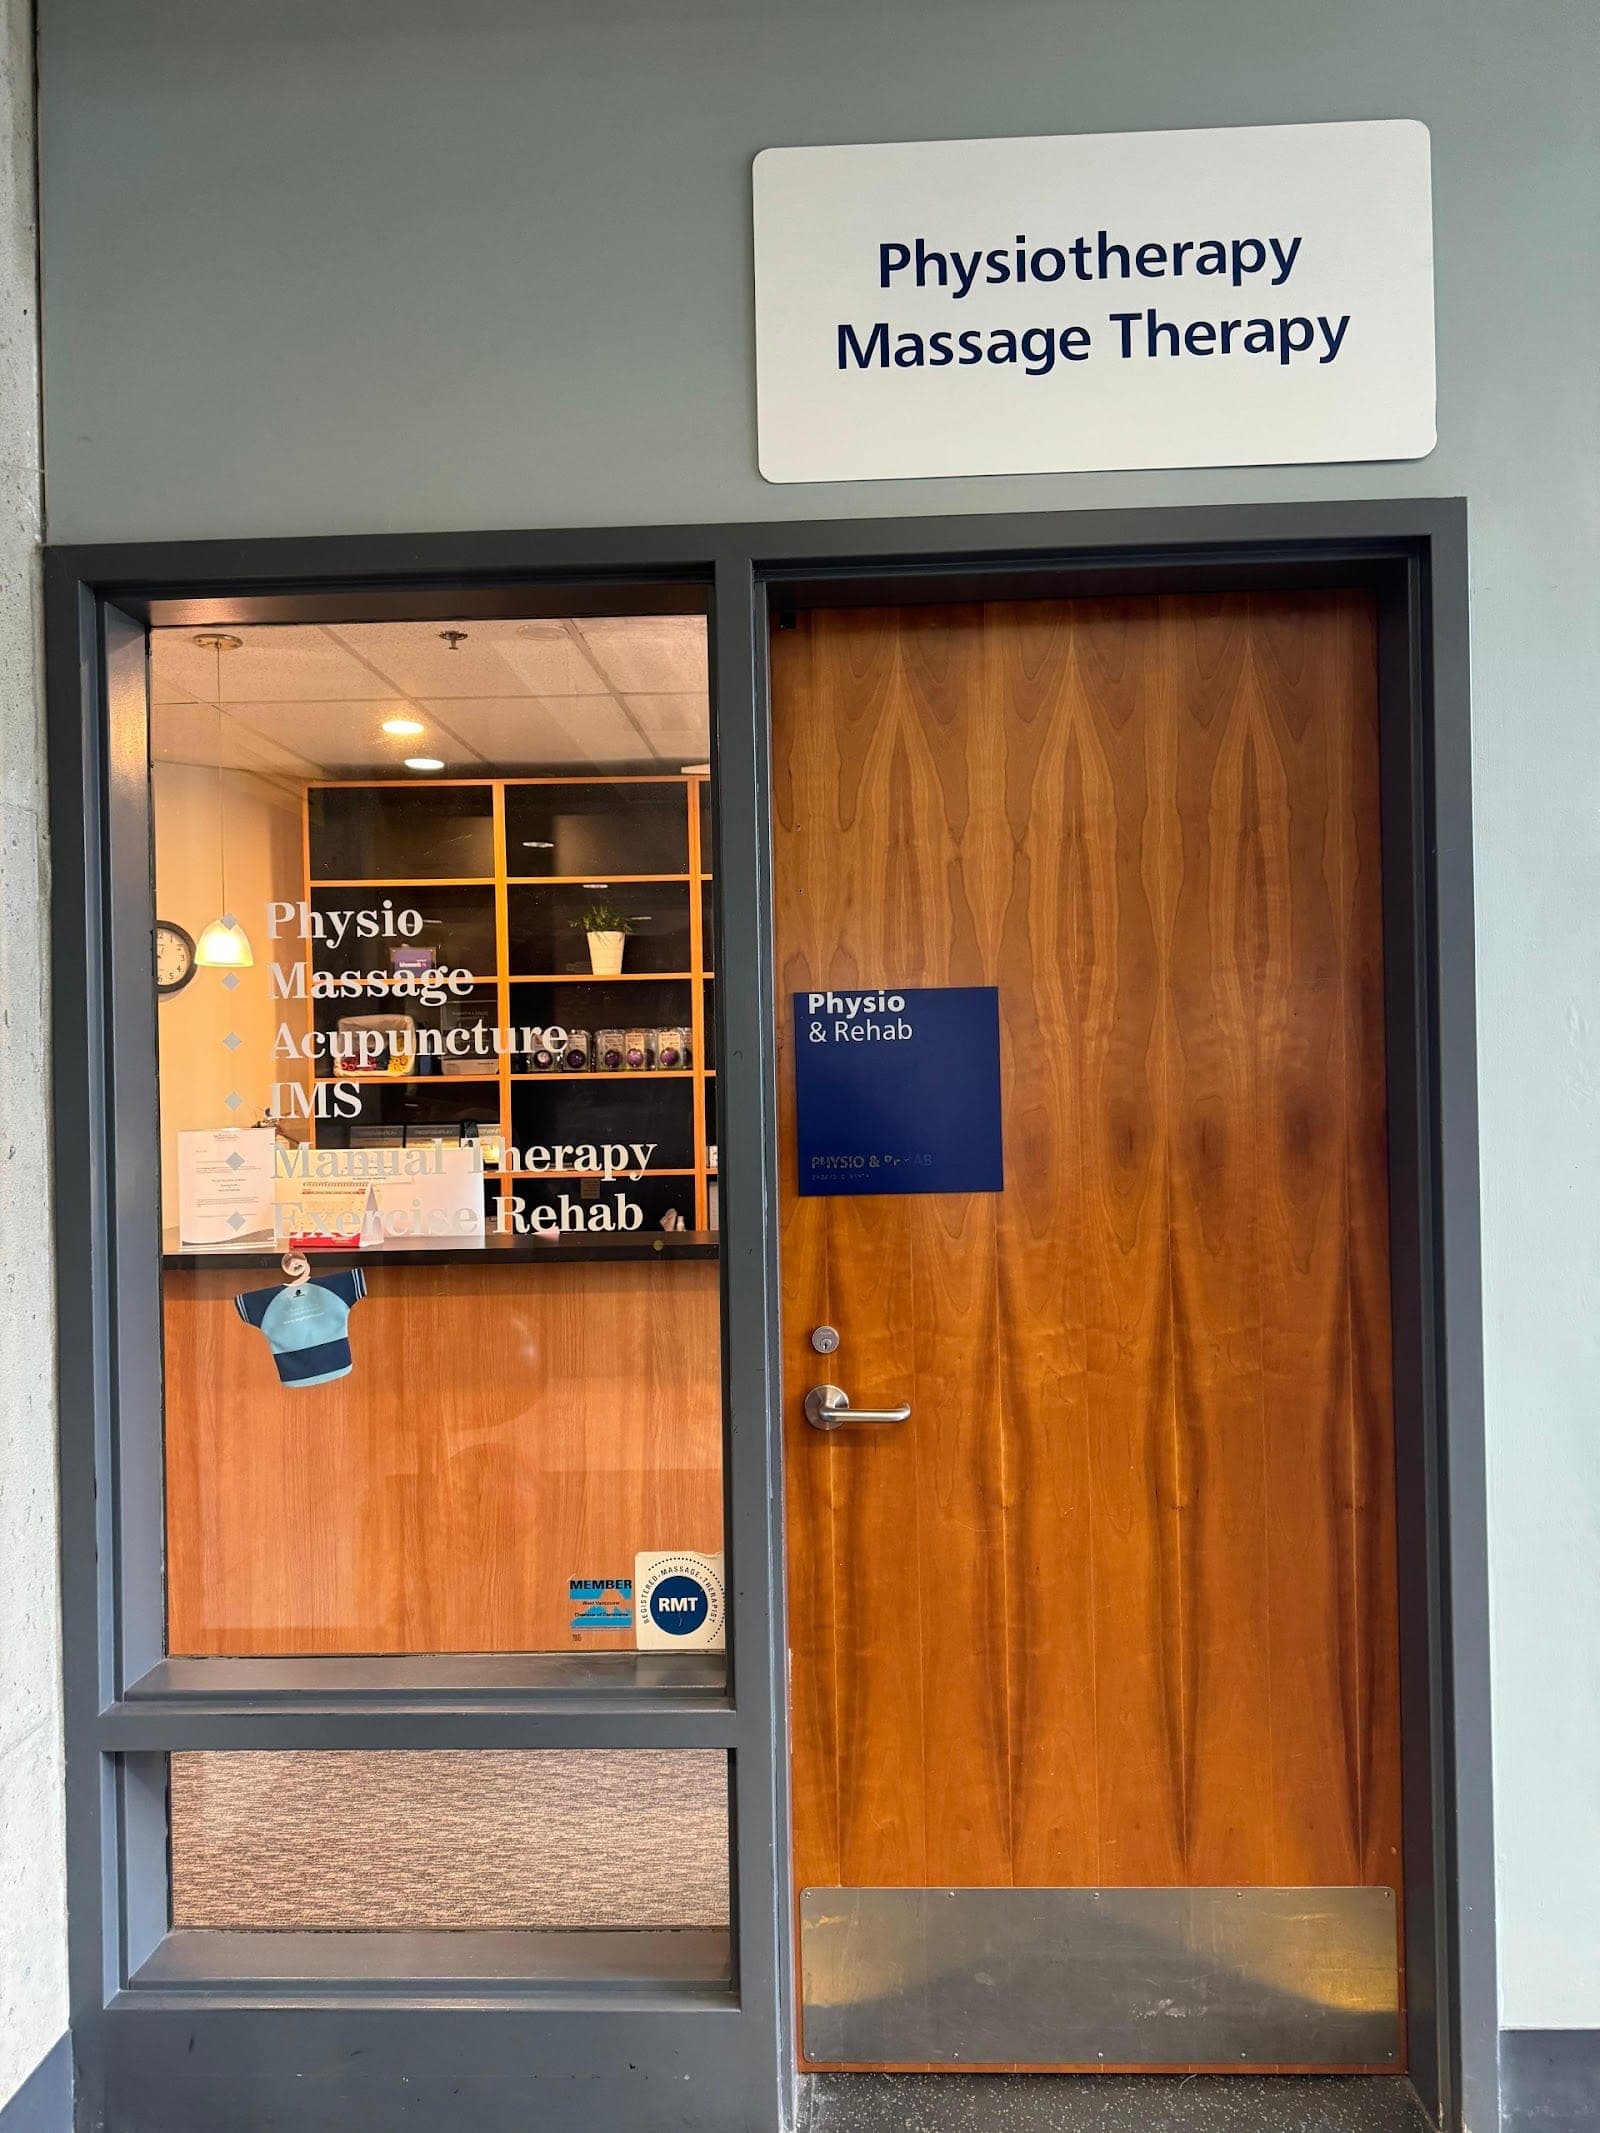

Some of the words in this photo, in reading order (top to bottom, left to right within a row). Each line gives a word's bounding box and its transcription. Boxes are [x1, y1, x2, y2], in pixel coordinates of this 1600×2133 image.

[879, 230, 1303, 299] Physiotherapy
[836, 322, 1091, 376] Massage
[1109, 308, 1351, 366] Therapy
[266, 899, 425, 949] Physio
[266, 961, 475, 1006] Massage
[808, 990, 906, 1019] Physio
[269, 1020, 569, 1069] Acupuncture
[808, 1021, 828, 1043] &
[834, 1018, 913, 1042] Rehab
[267, 1081, 363, 1119] IMS
[268, 1137, 446, 1180] Manual
[460, 1136, 658, 1182] Therapy
[811, 1155, 865, 1169] PHYSIO
[868, 1154, 880, 1168] &
[269, 1199, 479, 1239] Exercise
[491, 1193, 644, 1234] Rehab
[569, 1579, 632, 1590] MEMBER
[658, 1597, 699, 1613] RMT
[660, 1565, 701, 1577] MASSAGE
[702, 1577, 719, 1624] THERAPIST
